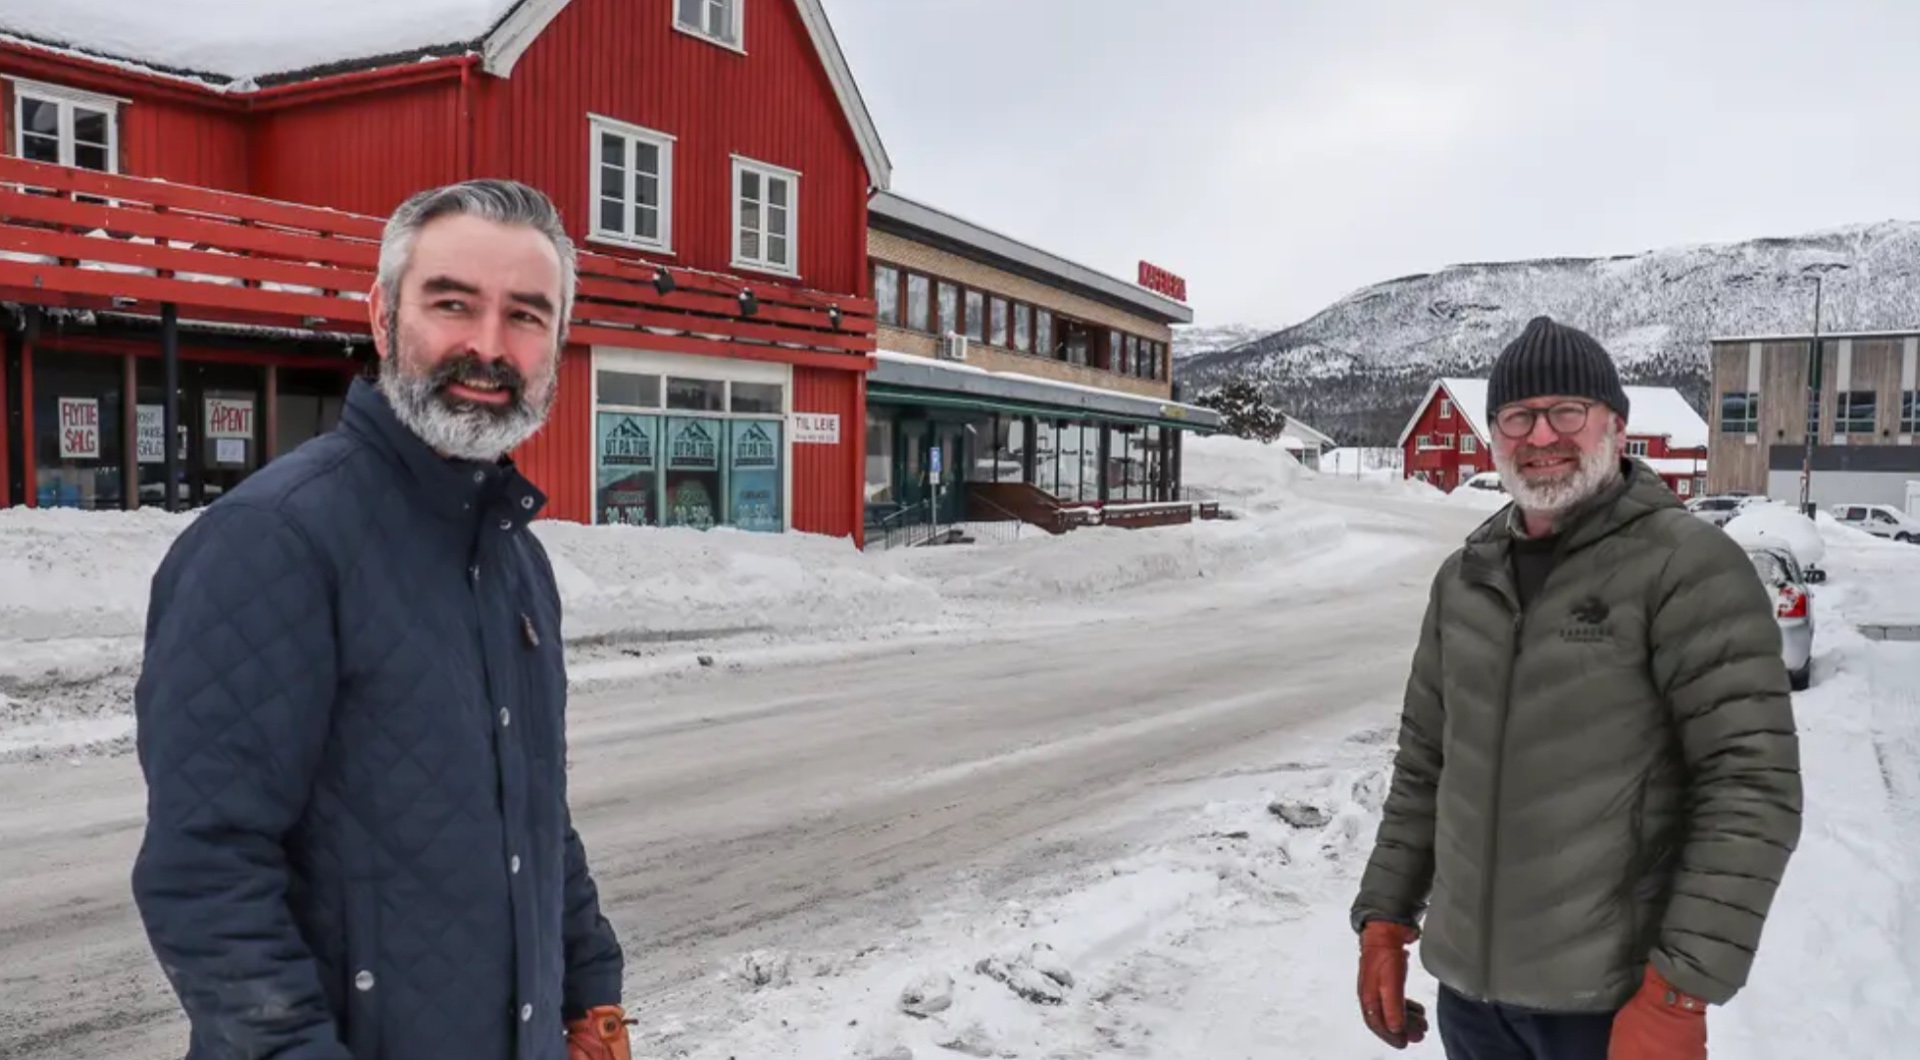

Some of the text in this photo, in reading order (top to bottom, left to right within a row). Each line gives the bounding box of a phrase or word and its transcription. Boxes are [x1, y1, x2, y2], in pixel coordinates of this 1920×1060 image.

[796, 416, 835, 431] TIL LEIE
[65, 428, 95, 453] SALG
[605, 439, 616, 454] UT
[632, 440, 649, 456] TUR
[674, 441, 685, 456] UT
[699, 442, 715, 457] TUR
[737, 443, 747, 456] UT
[760, 443, 773, 457] TUR
